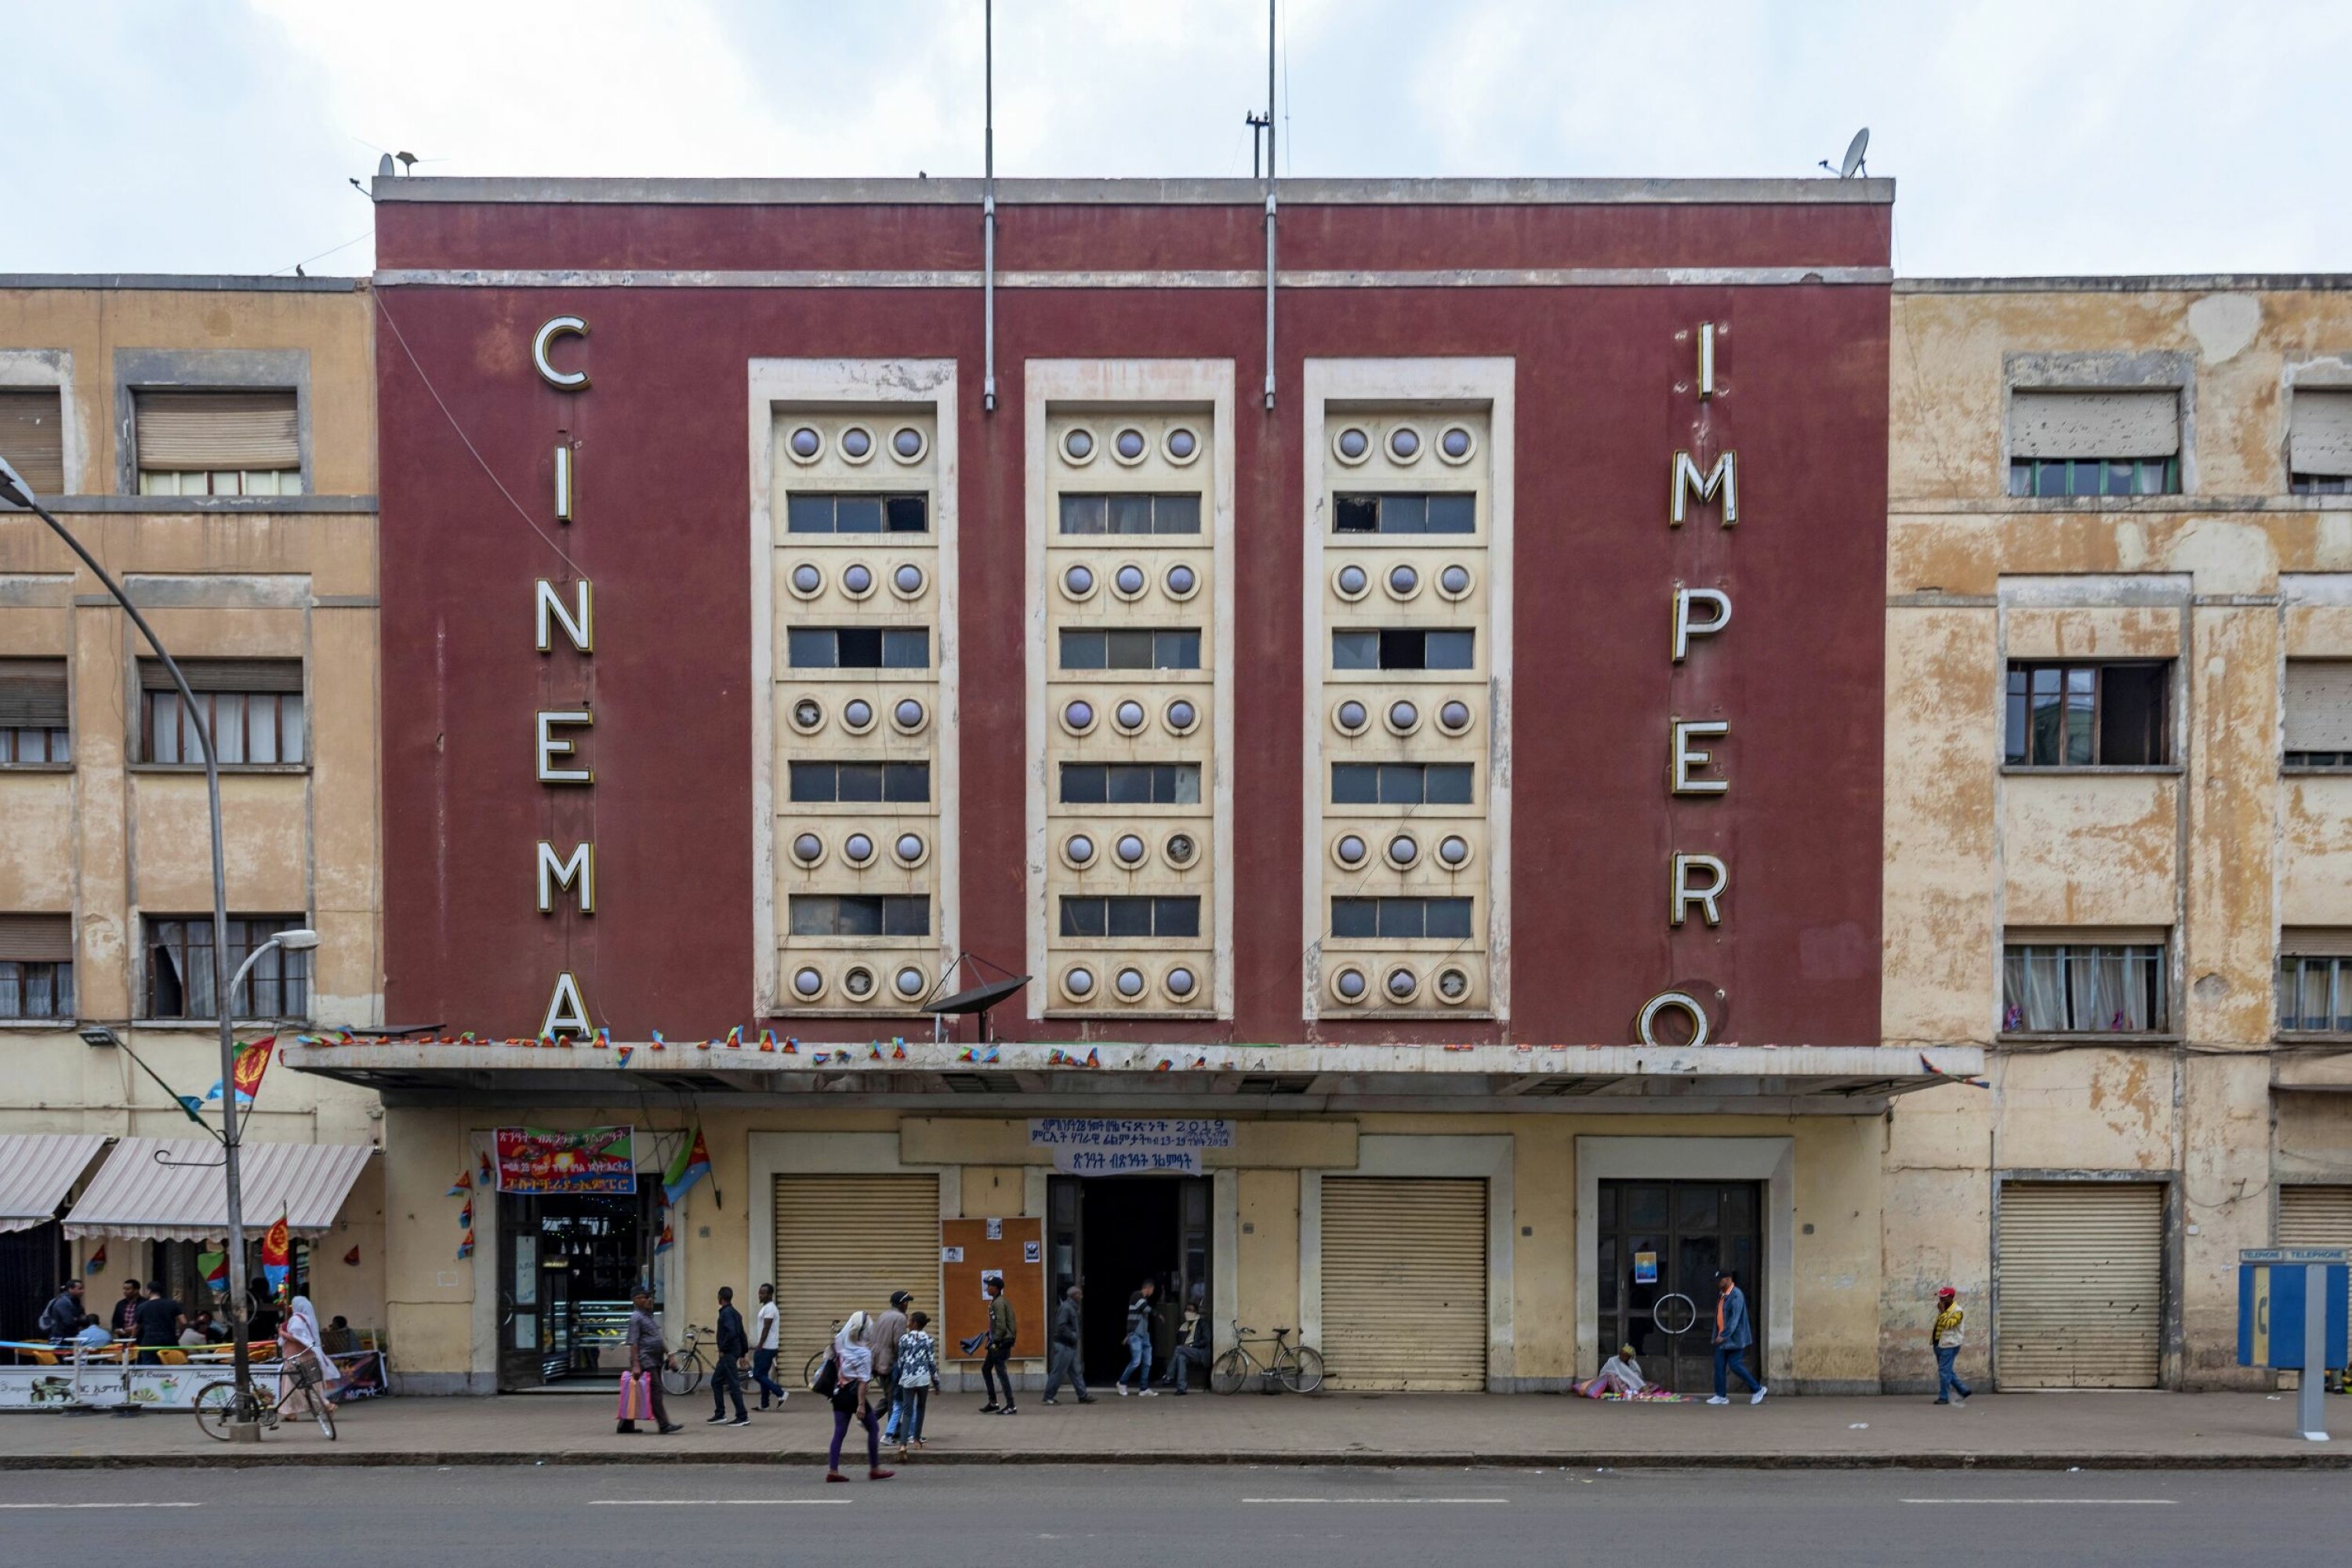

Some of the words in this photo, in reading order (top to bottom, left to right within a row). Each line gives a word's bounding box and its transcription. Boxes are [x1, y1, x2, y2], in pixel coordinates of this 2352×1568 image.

[532, 314, 595, 1040] CINEMA
[1633, 321, 1739, 1046] IMPERO
[1121, 1120, 1168, 1132] ናጽነት
[1176, 1120, 1225, 1131] 2019
